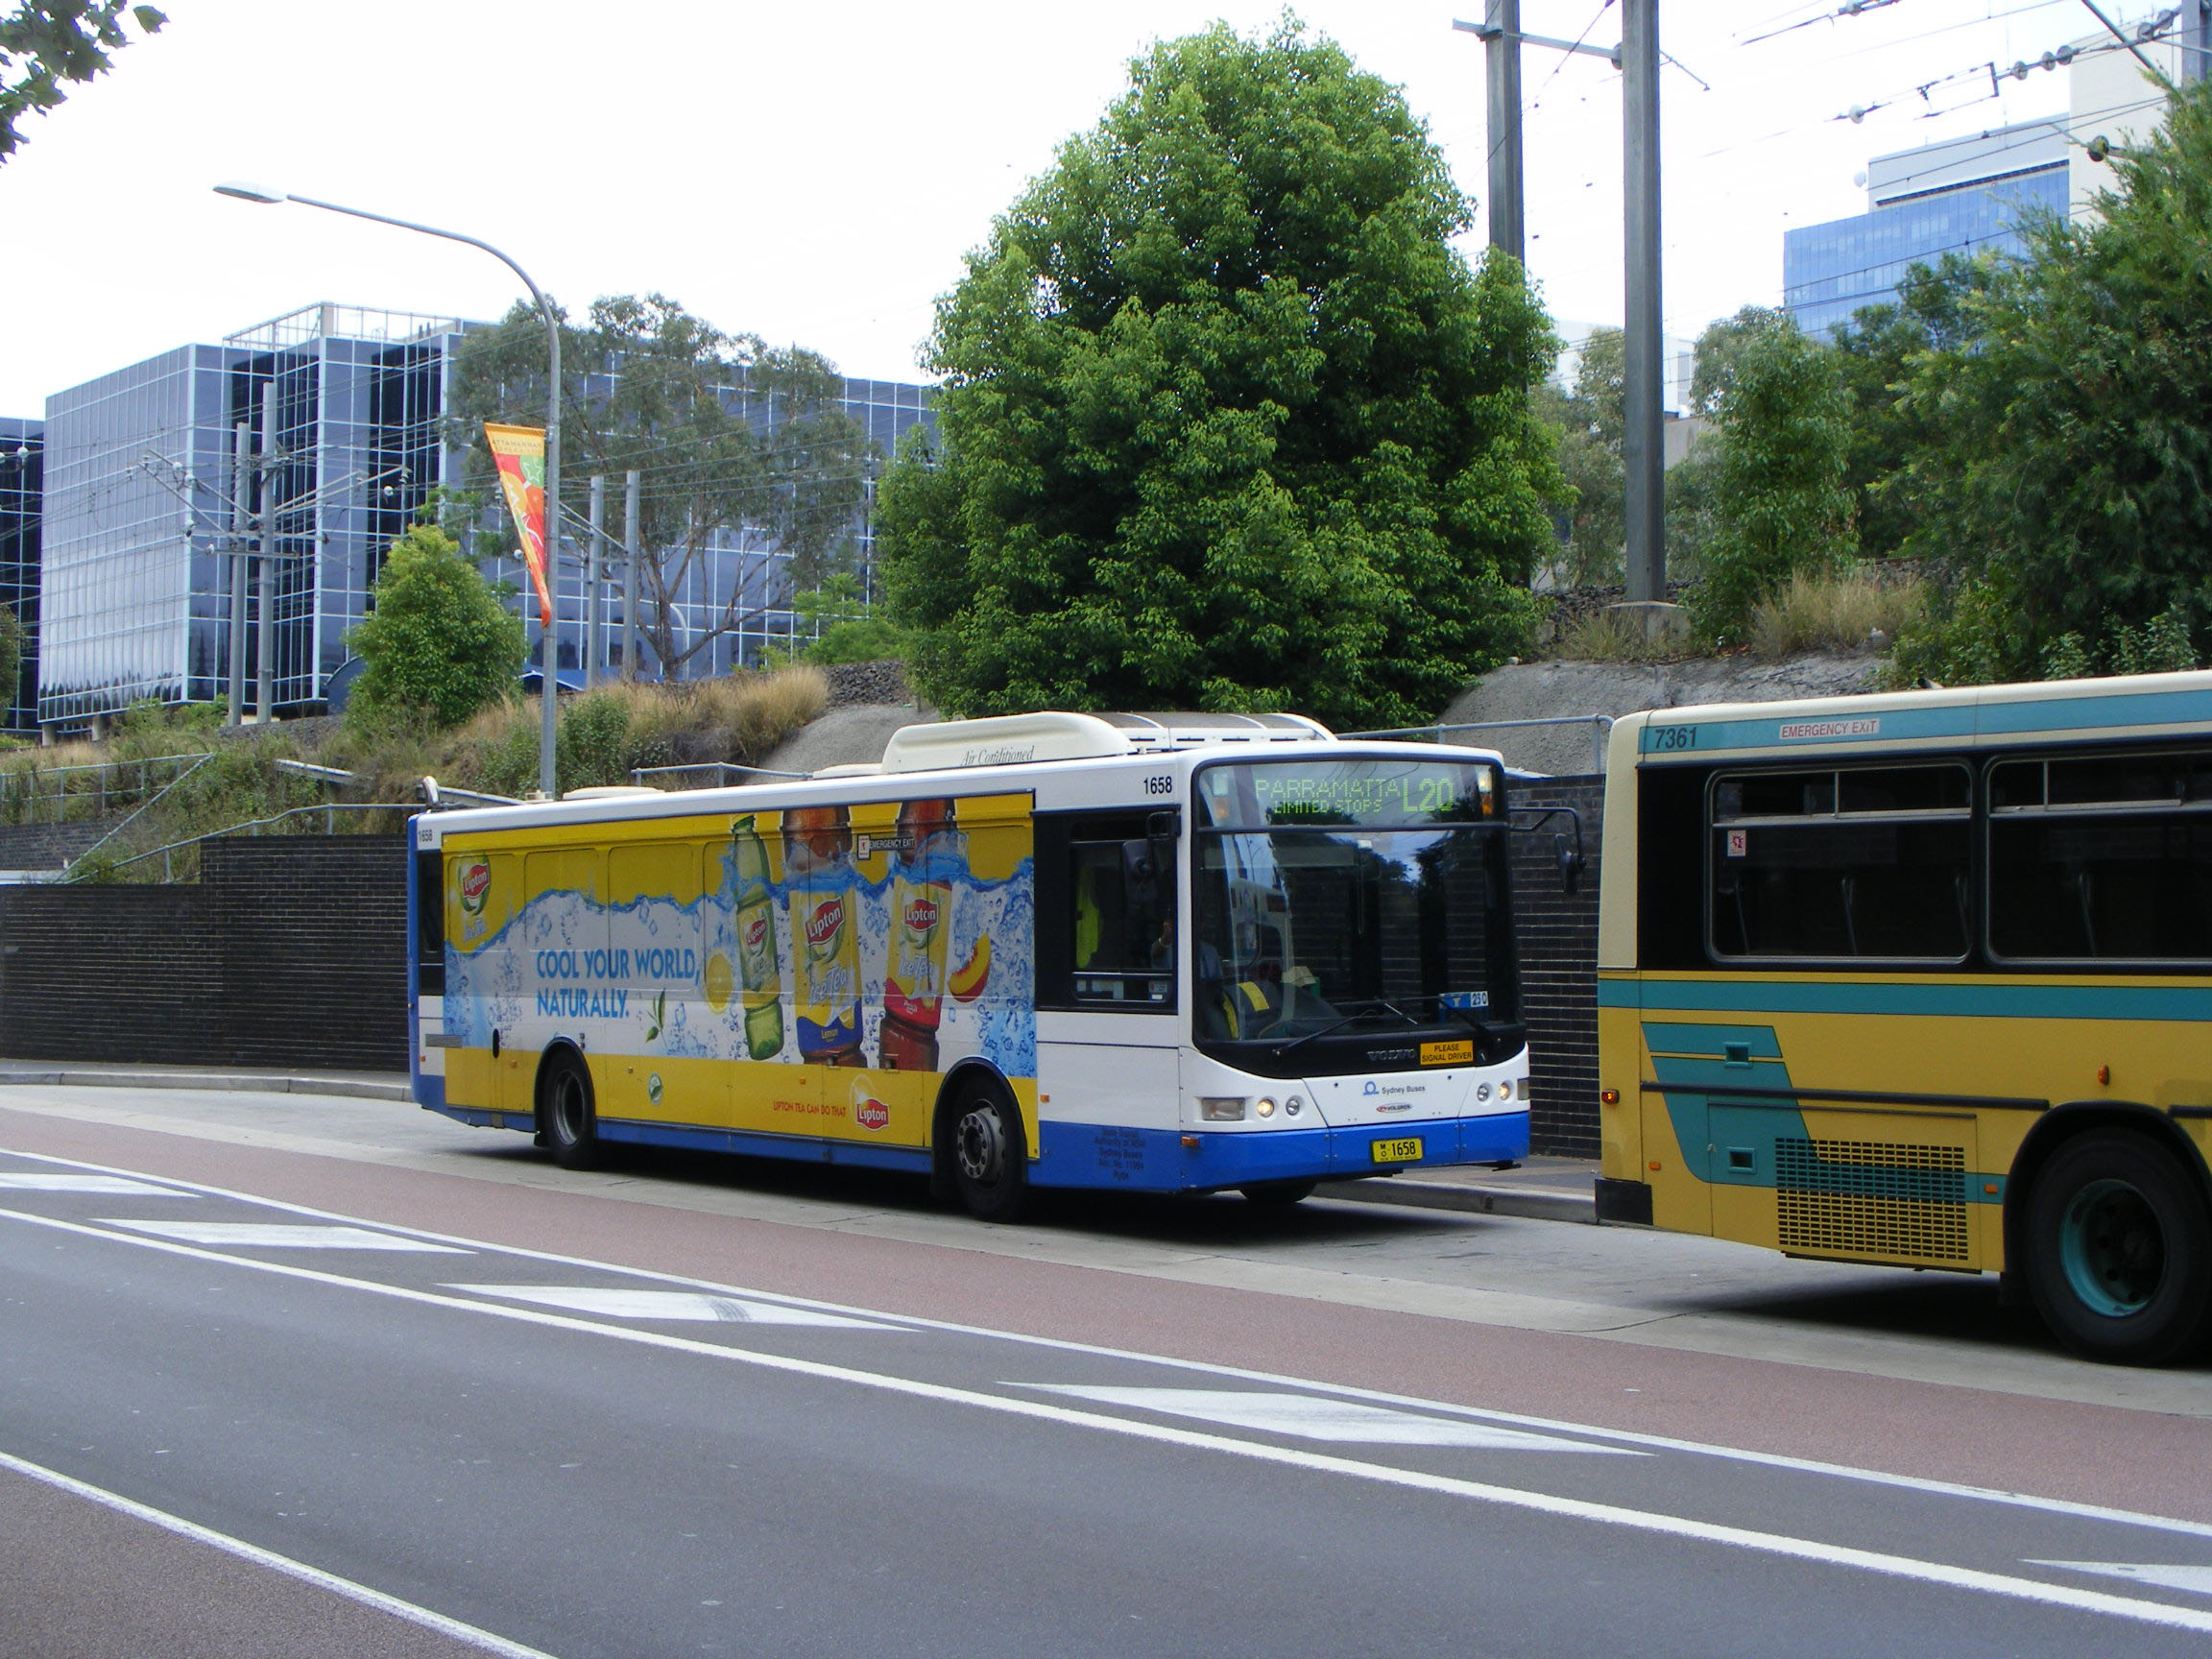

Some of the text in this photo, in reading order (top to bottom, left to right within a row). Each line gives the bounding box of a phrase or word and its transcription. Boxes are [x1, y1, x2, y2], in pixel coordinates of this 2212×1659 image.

[1655, 727, 1697, 749] 7361
[1781, 720, 1877, 738] EMERGENCY EXIT
[960, 744, 1035, 766] Air Conditioned
[1143, 776, 1172, 795] 1658
[1255, 778, 1401, 799] PARRAMATTA
[1402, 778, 1454, 812] L20
[1274, 799, 1382, 814] LIMITED STOPS
[418, 829, 433, 842] 1658
[869, 838, 902, 849] EMERGENCY
[462, 871, 488, 893] Lipton
[806, 904, 842, 938] Lipton
[905, 908, 937, 925] Lipton
[746, 921, 767, 946] Lipton
[537, 948, 701, 986] COOL YOUR WORLD,
[899, 958, 916, 977] Ice
[807, 965, 848, 1008] Ice Tea
[536, 988, 631, 1019] NATURALLY.
[1422, 1051, 1472, 1063] SIGNAL DRIVER
[1433, 1043, 1459, 1052] PLEASE
[1382, 1086, 1405, 1095] Sydney
[772, 1100, 793, 1113] LIPTON
[794, 1102, 805, 1114] TEA
[806, 1104, 820, 1115] CAN
[831, 1107, 847, 1118] THAT
[858, 1106, 888, 1123] Lipton
[1391, 1141, 1416, 1156] 1658
